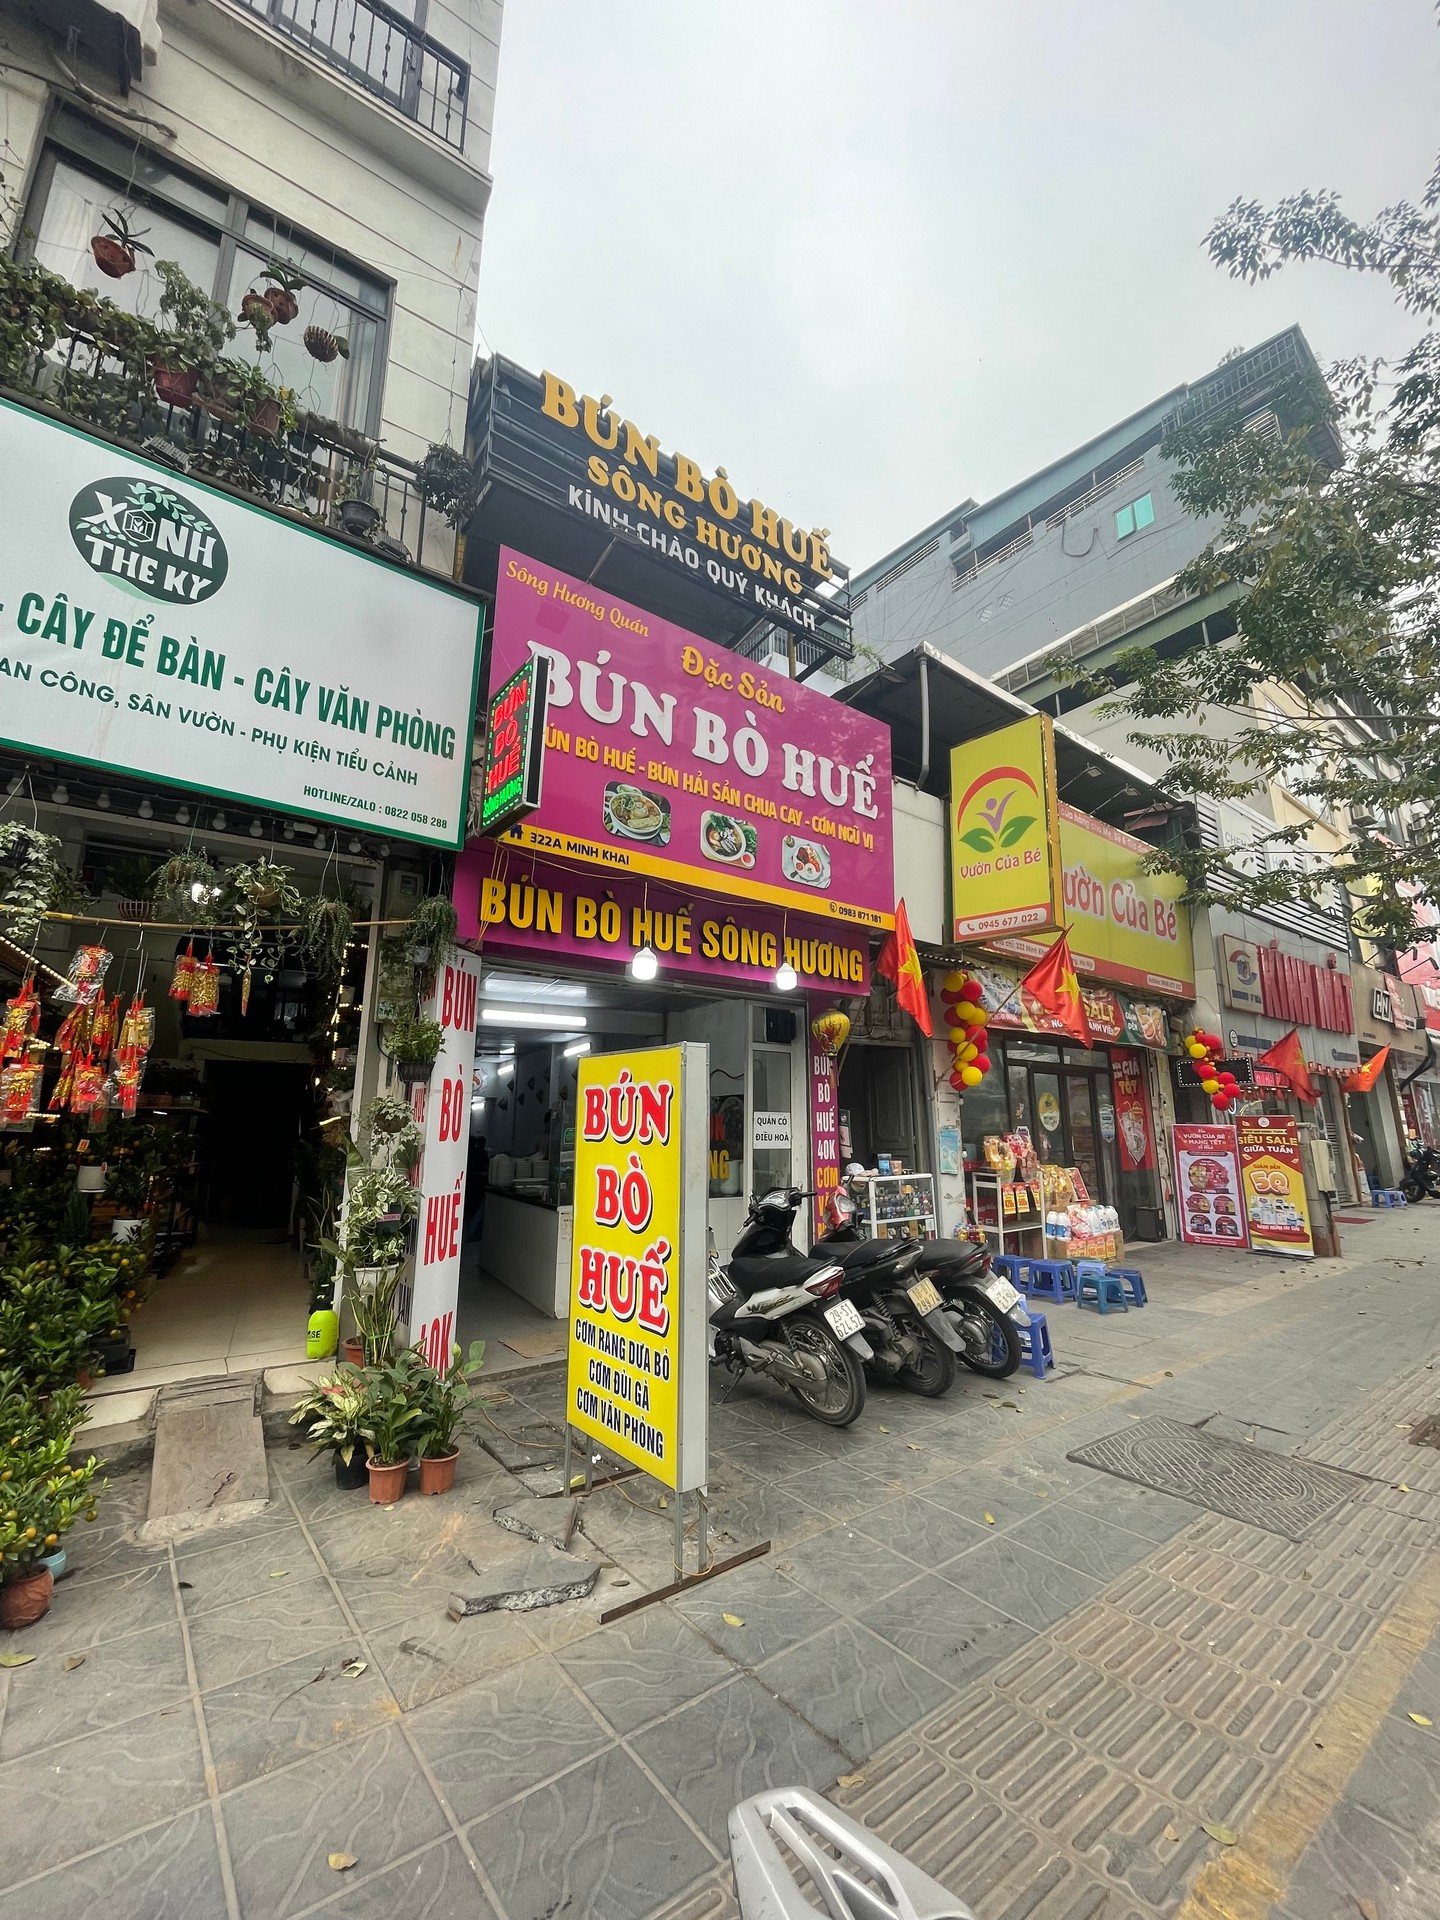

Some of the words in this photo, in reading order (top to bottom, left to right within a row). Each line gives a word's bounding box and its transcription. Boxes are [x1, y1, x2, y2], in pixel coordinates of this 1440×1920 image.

[540, 370, 661, 477] BÚN
[675, 452, 738, 520] BÒ
[750, 500, 833, 580] HUẾ
[568, 484, 629, 530] KÍNH
[636, 522, 699, 569] CHÀO
[707, 560, 748, 593] QUÝ
[755, 585, 815, 632] KHÁCH
[587, 455, 687, 529] SÔNG
[695, 516, 803, 595] HƯƠNG
[84, 533, 156, 585] THE
[163, 561, 213, 601] KY
[505, 561, 549, 595] Sông
[553, 580, 605, 622] Hương
[609, 608, 649, 638] Quán
[16, 592, 96, 650] CÂY
[102, 613, 156, 668] ĐỂ
[157, 636, 226, 691] BÀN
[254, 667, 311, 716] CÂY
[318, 686, 369, 732] VĂN
[376, 709, 456, 760] PHÒNG
[493, 679, 527, 731] BÚN
[681, 645, 733, 692] Đặc
[737, 672, 785, 714] Sản
[0, 657, 32, 680] AN
[40, 671, 120, 707] CÔNG,
[128, 692, 171, 719] SÂN
[179, 709, 235, 736] VƯỜN
[251, 727, 288, 752] PHỤ
[293, 740, 331, 765] KIỆN
[336, 748, 368, 772] TIỂU
[372, 757, 418, 786] CẢNH
[494, 716, 519, 758] BÒ
[527, 640, 677, 746] BÚN
[692, 707, 768, 777] BÒ
[781, 742, 878, 820] HUẾ
[303, 785, 376, 812] HOTLINE/ZALO
[385, 805, 408, 820] 0822
[410, 810, 429, 824] 058
[430, 815, 447, 829] 288
[545, 725, 570, 754] ÚN
[575, 736, 599, 762] BÒ
[603, 746, 636, 776] HUẾ
[647, 760, 679, 788] BÚN
[682, 769, 708, 797] HẢI
[711, 777, 741, 808] SẢN
[743, 792, 777, 819] CHUA
[779, 803, 803, 827] CAY
[811, 814, 836, 839] CƠM
[837, 822, 861, 846] NGŨ
[862, 832, 874, 852] VỊ
[530, 832, 562, 850] 322A
[566, 840, 599, 859] MINH
[602, 847, 630, 866] KHAI
[960, 857, 991, 879] Vườn
[995, 853, 1020, 872] Của
[1024, 848, 1042, 866] Bé
[479, 875, 563, 935] BÚN
[575, 890, 621, 943] BÒ
[632, 903, 694, 955] HUẾ
[702, 915, 776, 969] SÔNG
[785, 935, 863, 983] HƯƠNG
[838, 906, 856, 919] 0983
[857, 909, 870, 921] 871
[870, 911, 882, 923] 181
[978, 917, 1001, 931] 0945
[1002, 915, 1019, 927] 677
[1020, 912, 1039, 924] 022
[1064, 866, 1105, 917] ườn
[1111, 882, 1149, 932] Của
[1153, 899, 1177, 941] Bé
[441, 958, 477, 1033] BÚN
[438, 1063, 465, 1144] BÒ
[582, 1068, 674, 1146] BÚN
[756, 1116, 777, 1126] QUÁN
[778, 1116, 788, 1126] CÓ
[816, 1106, 835, 1132] HUẾ
[818, 1079, 830, 1102] BÒ
[755, 1132, 773, 1142] ĐIỀU
[817, 1139, 836, 1160] 40K
[1238, 1134, 1263, 1145] SIÊU
[1266, 1136, 1298, 1146] SALE
[1243, 1145, 1265, 1153] GIỮA
[594, 1152, 653, 1233] BÒ
[817, 1165, 838, 1188] CƠM
[423, 1171, 464, 1266] HUẾ
[578, 1237, 671, 1339] HUẾ
[829, 1303, 853, 1324] 29-S1
[575, 1318, 597, 1349] CƠM
[598, 1327, 627, 1363] RANG
[629, 1342, 651, 1374] DƯA
[654, 1347, 671, 1382] BÒ
[835, 1314, 863, 1338] 624.52
[588, 1357, 612, 1391] CƠM
[613, 1369, 633, 1401] ĐÙI
[634, 1377, 651, 1412] GÀ
[576, 1386, 599, 1420] CƠM
[600, 1396, 622, 1433] VĂN
[624, 1409, 664, 1460] PHÒNG
